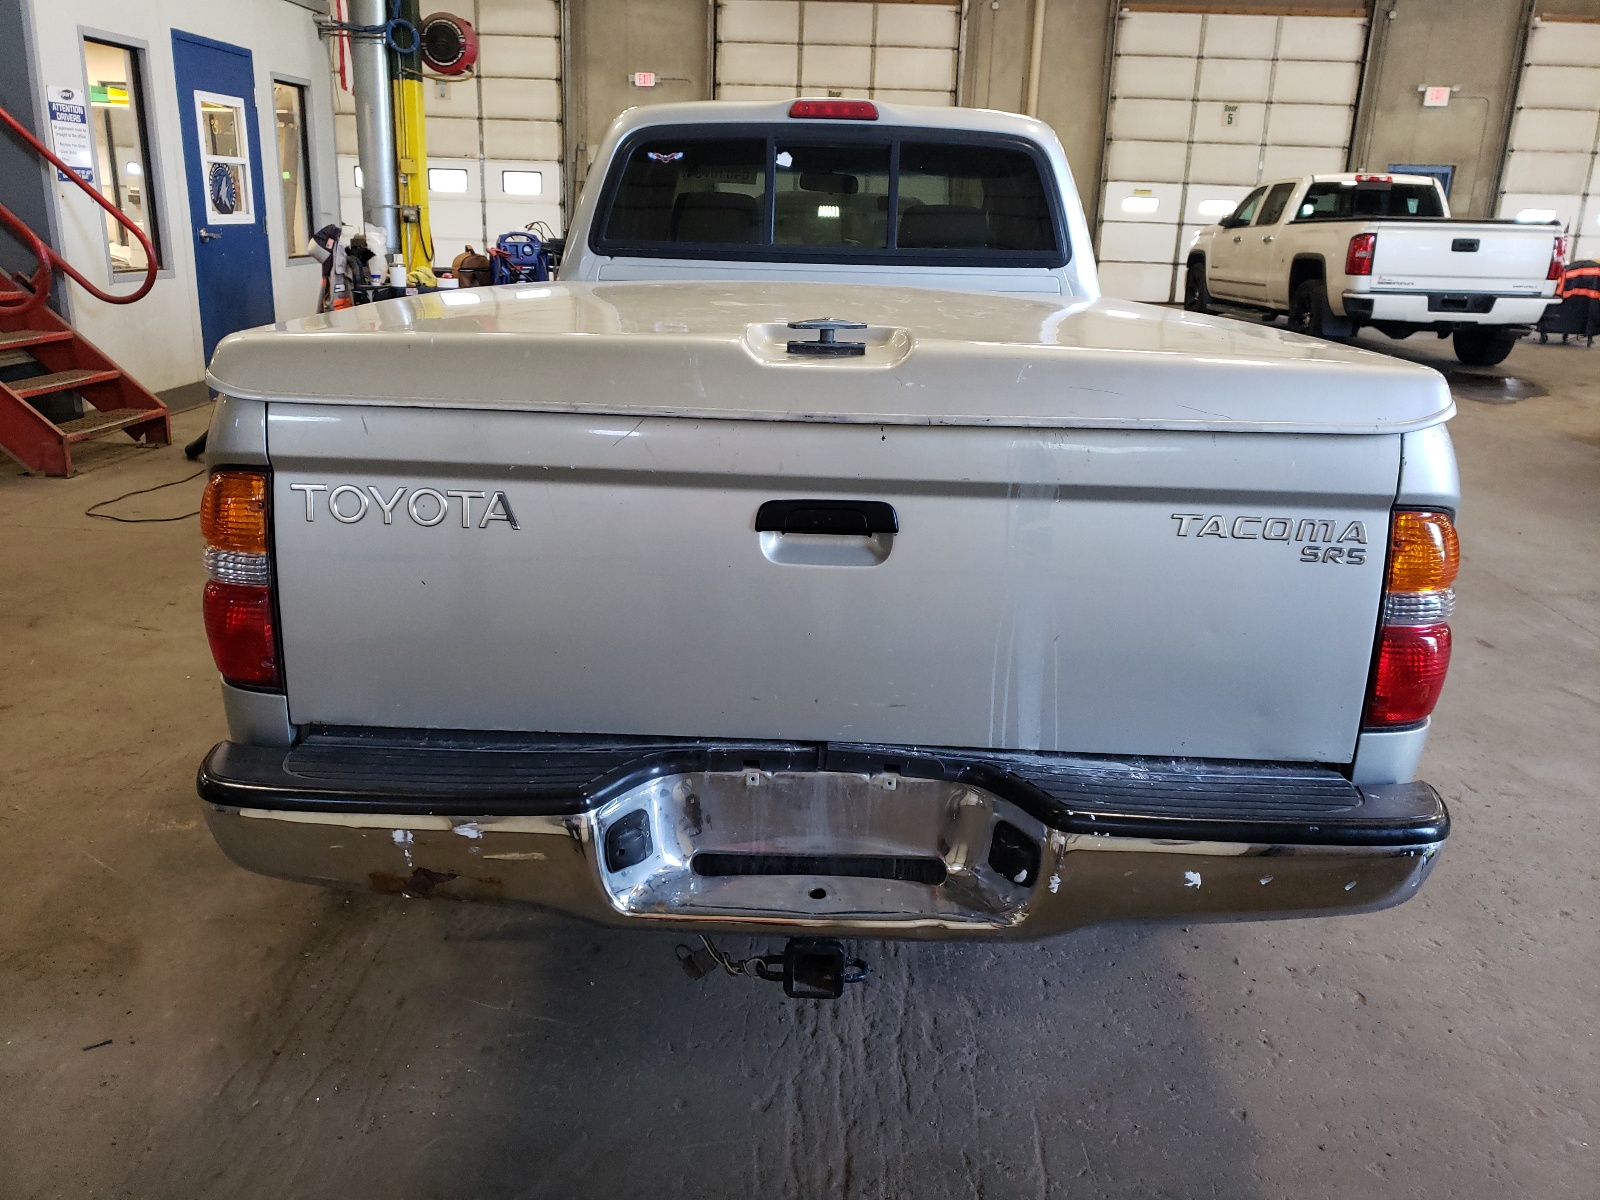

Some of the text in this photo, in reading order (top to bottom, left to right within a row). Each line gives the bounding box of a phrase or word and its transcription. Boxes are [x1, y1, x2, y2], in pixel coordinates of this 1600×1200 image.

[52, 103, 83, 114] ATTENTION
[56, 113, 81, 122] DRIVERS
[1227, 113, 1233, 125] 5
[290, 483, 520, 531] TOYOTA
[1171, 513, 1369, 544] TACOMA
[1300, 545, 1368, 565] SR5
